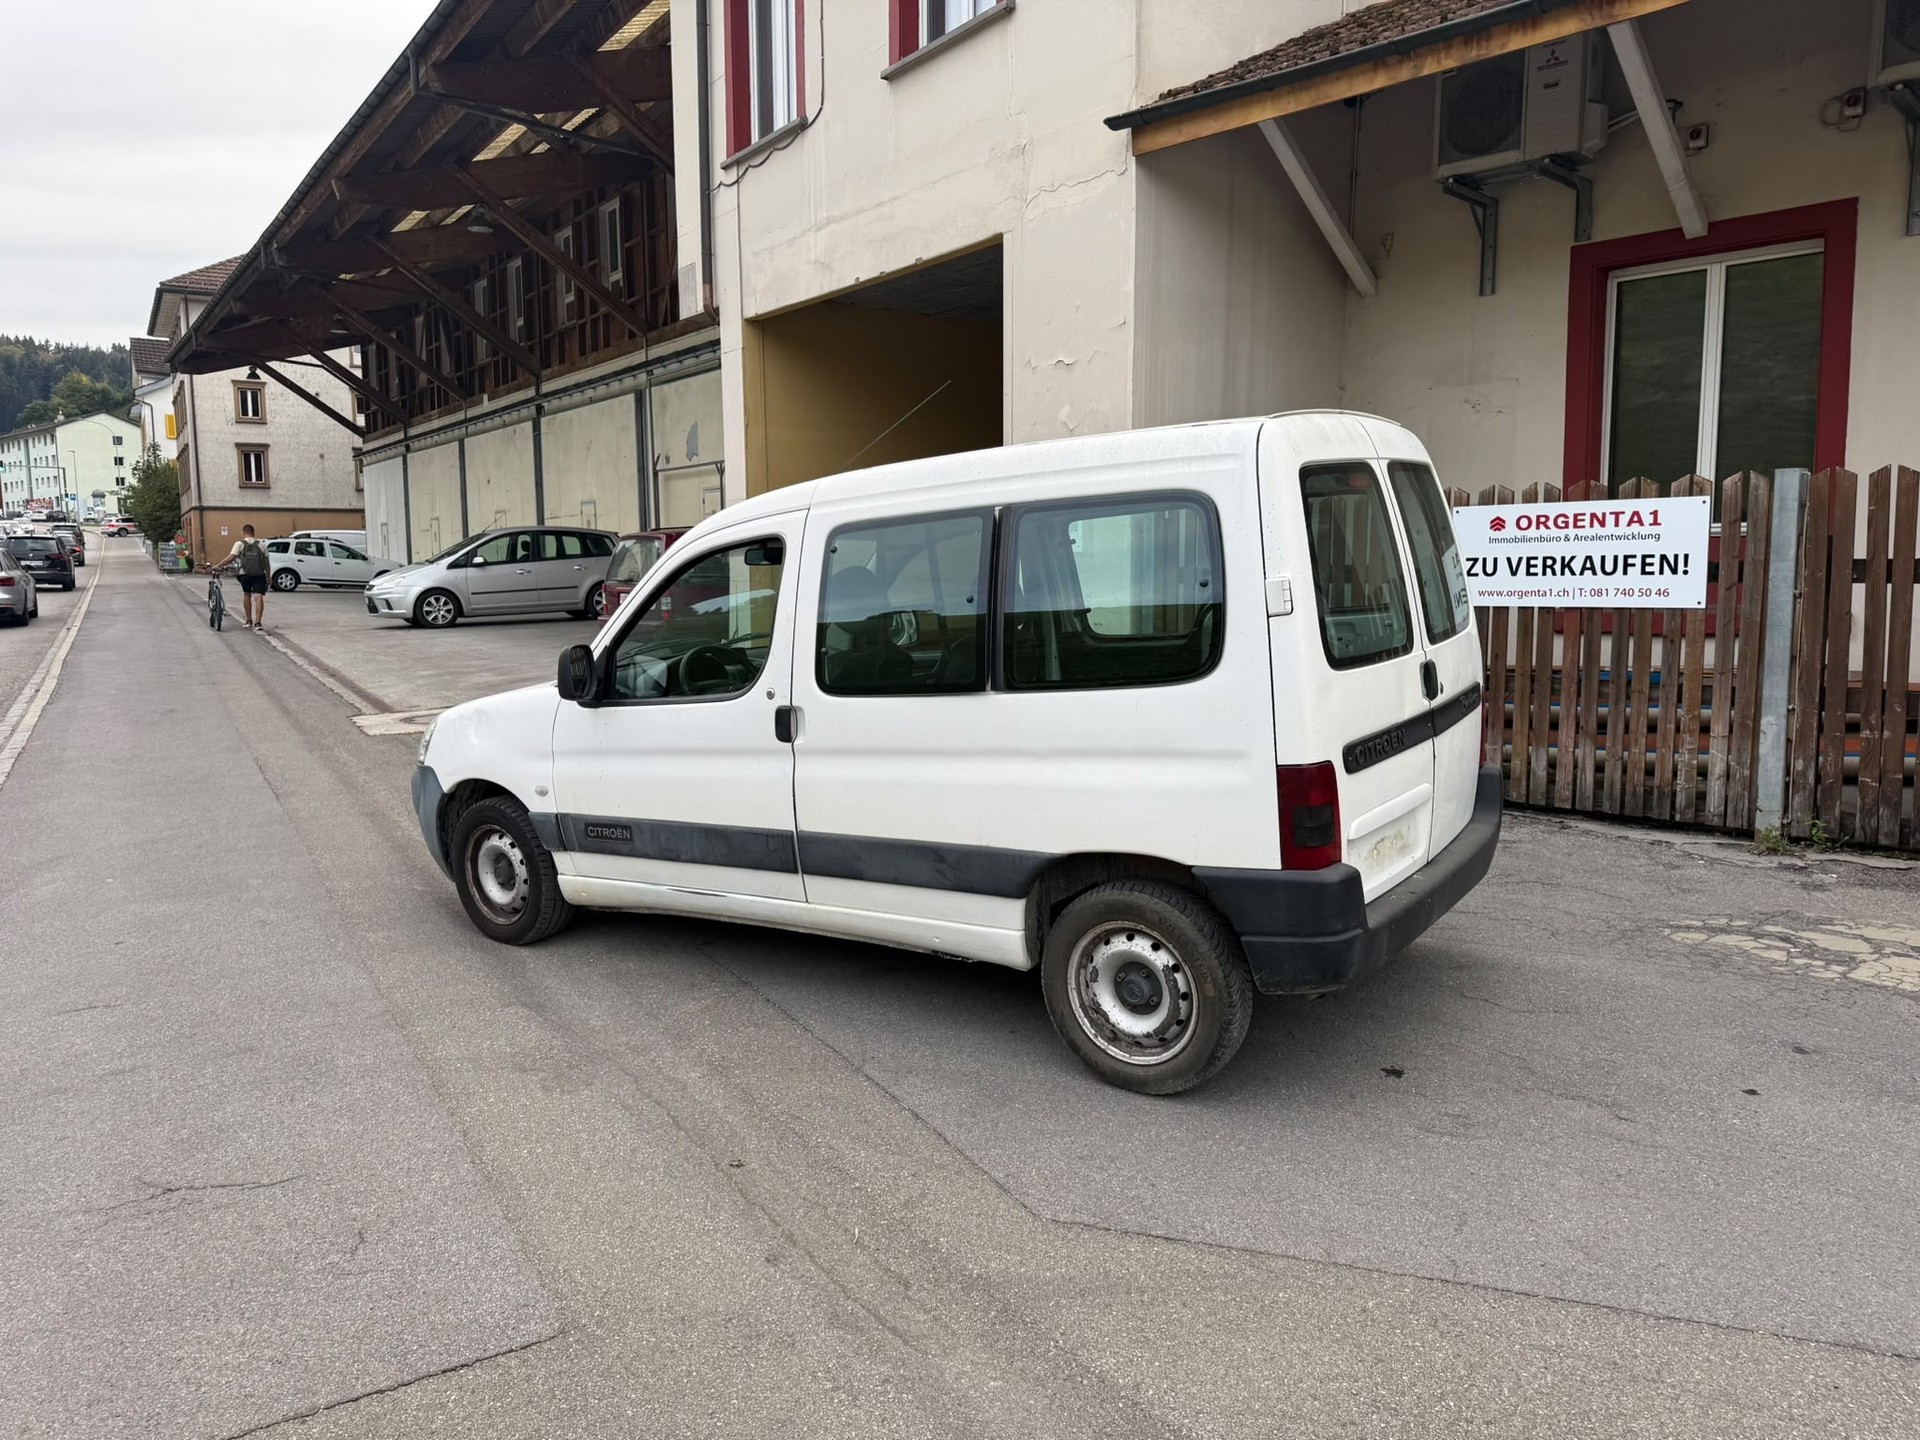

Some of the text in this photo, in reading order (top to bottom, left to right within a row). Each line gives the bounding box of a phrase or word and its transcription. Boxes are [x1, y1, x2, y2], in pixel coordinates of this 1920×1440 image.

[1515, 509, 1662, 531] ORGENTA1
[1488, 531, 1661, 544] Immobilienbüro & Arealentwicklung
[1465, 556, 1498, 577] ZU
[1506, 553, 1690, 577] VERKAUFEN!
[1478, 587, 1570, 600] www.orgenta1.ch
[1577, 588, 1588, 598] T:
[1589, 587, 1610, 598] 081
[1613, 587, 1635, 598] 740
[1637, 587, 1652, 598] 50
[1654, 587, 1670, 598] 46
[1355, 727, 1406, 766] CITROËN
[587, 826, 631, 839] CITROËN
